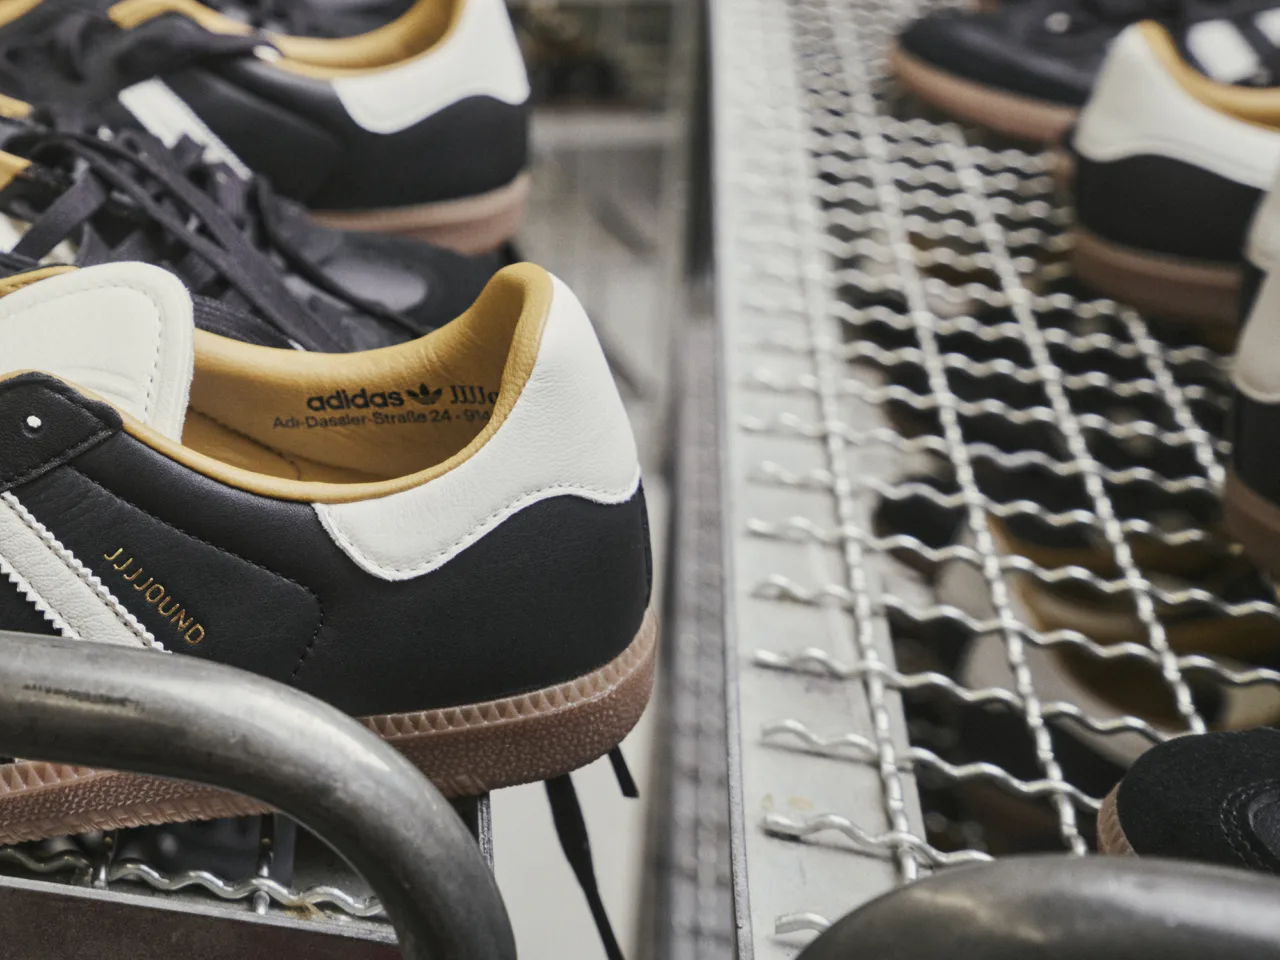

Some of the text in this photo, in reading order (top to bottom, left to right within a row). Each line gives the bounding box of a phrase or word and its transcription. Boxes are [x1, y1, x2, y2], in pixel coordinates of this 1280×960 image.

[306, 387, 404, 411] adidas
[429, 409, 451, 422] 24
[103, 547, 205, 645] JJJJOUND
